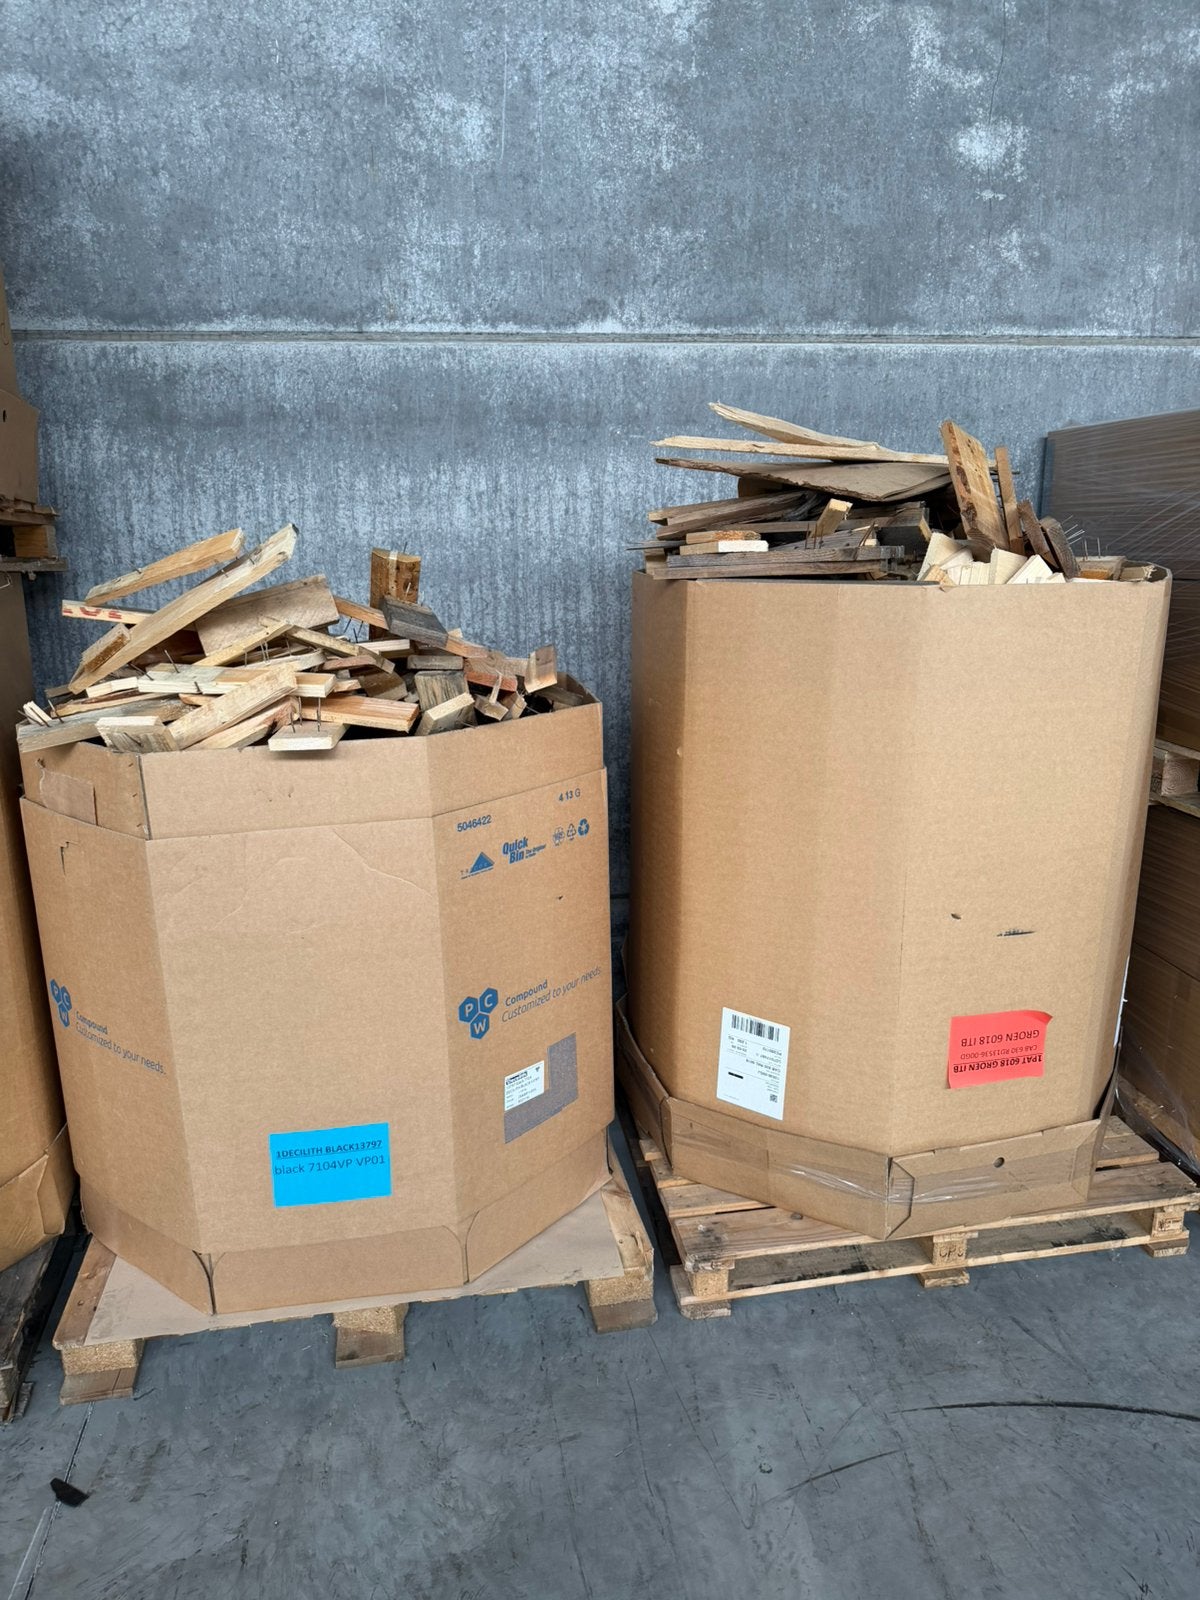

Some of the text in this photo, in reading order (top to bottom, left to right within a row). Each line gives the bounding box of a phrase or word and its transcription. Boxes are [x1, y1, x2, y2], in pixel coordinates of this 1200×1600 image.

[457, 814, 492, 832] 5046422
[502, 836, 529, 856] Quick
[508, 850, 525, 864] Bin
[501, 992, 551, 1023] Customized
[552, 986, 561, 998] to
[562, 978, 579, 997] your
[505, 979, 548, 1007] Compound
[76, 1010, 108, 1035] Compound
[76, 1021, 167, 1075] Customized to your needs.
[961, 1029, 1040, 1047] GROEN 6018 ITB
[953, 1055, 1043, 1073] 1PAT 6018 GROEN ITB
[276, 1140, 383, 1158] 1DECILITH BLACK13797
[274, 1154, 385, 1175] black 7104VP VP01
